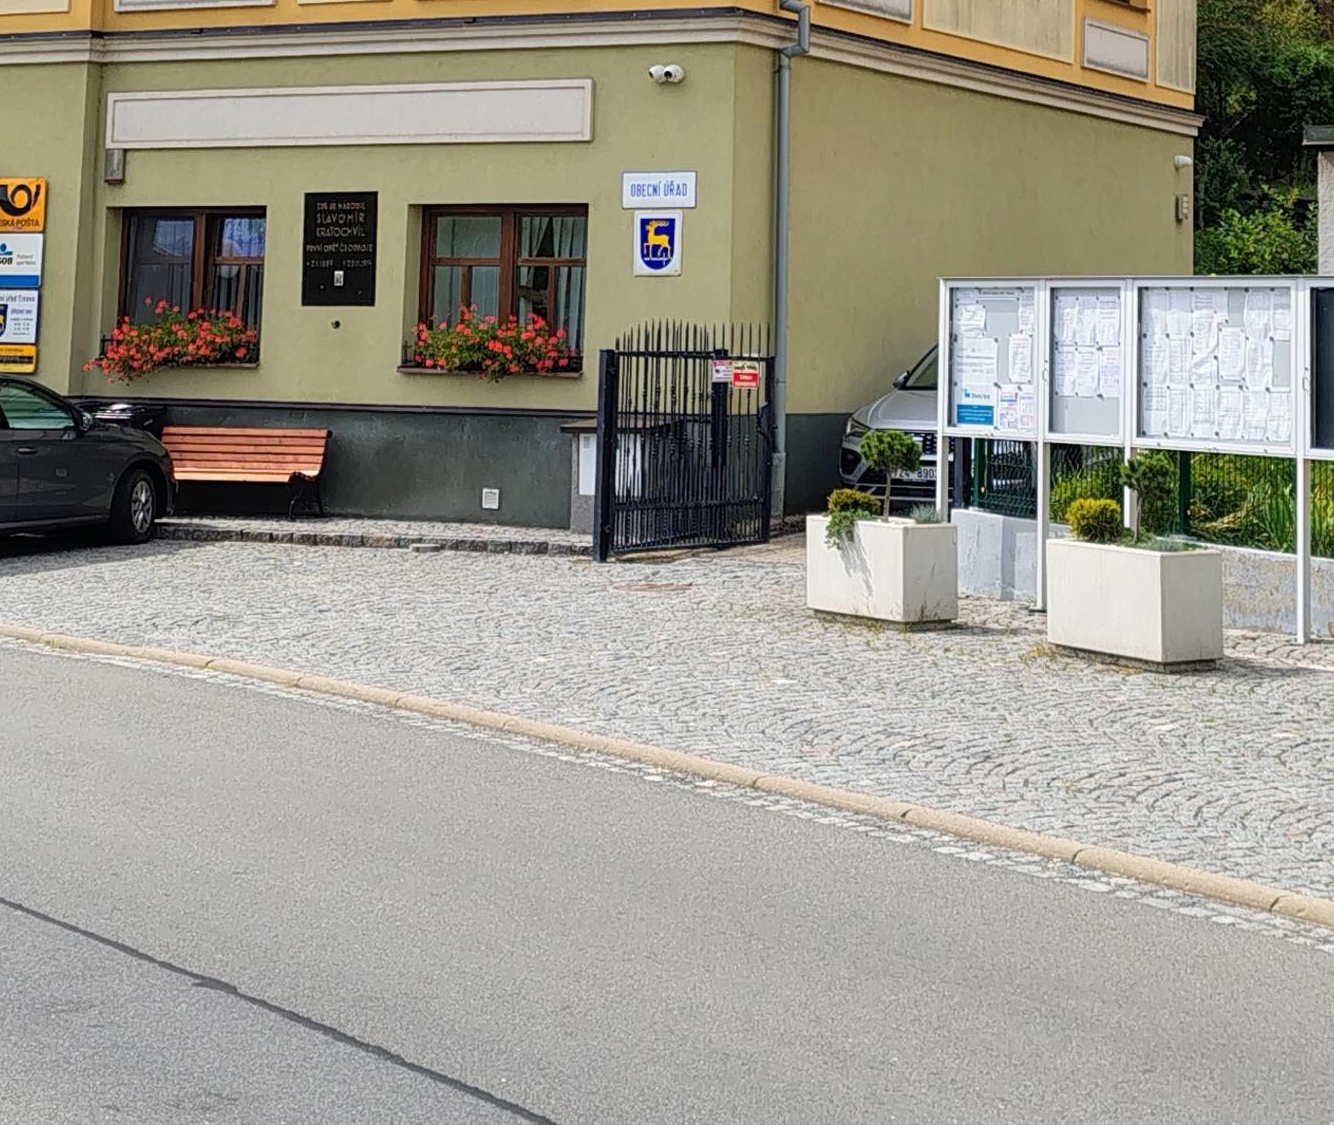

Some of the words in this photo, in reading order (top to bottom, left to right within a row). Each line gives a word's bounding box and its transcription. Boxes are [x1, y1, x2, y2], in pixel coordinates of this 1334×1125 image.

[630, 181, 661, 197] OBECNÍ
[663, 180, 688, 197] ÚŘAD
[16, 217, 40, 227] POŠTA
[315, 211, 365, 224] SLAVOMÍR
[315, 225, 366, 238] KRATOCHVÍL
